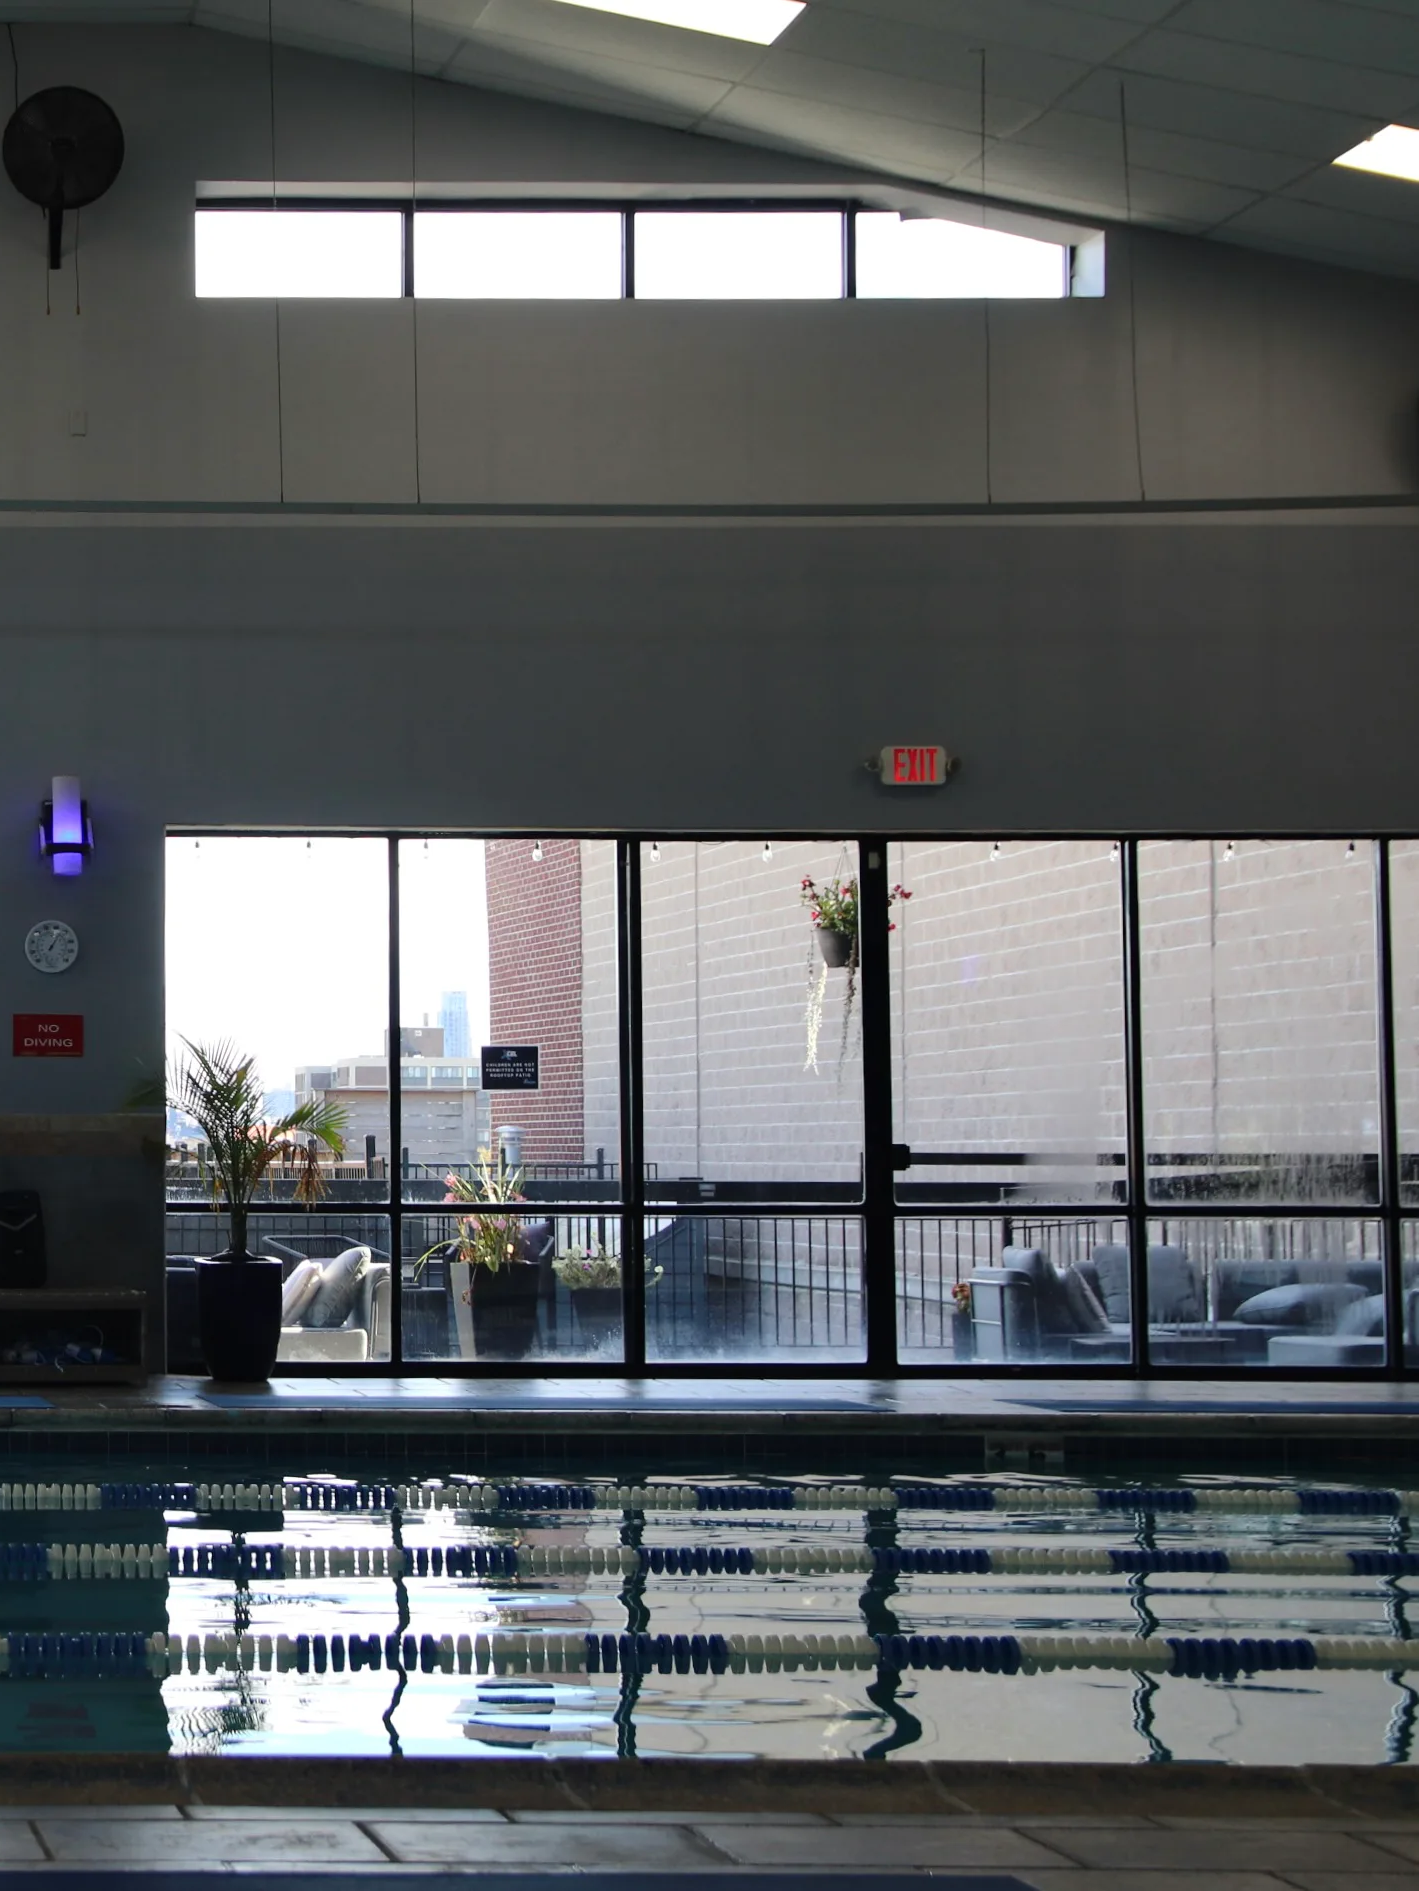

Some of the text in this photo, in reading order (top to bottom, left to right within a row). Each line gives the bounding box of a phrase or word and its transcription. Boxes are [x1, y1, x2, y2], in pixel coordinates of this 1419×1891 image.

[893, 748, 938, 782] EXIT
[38, 1024, 60, 1033] NO
[24, 1037, 73, 1047] DIVING
